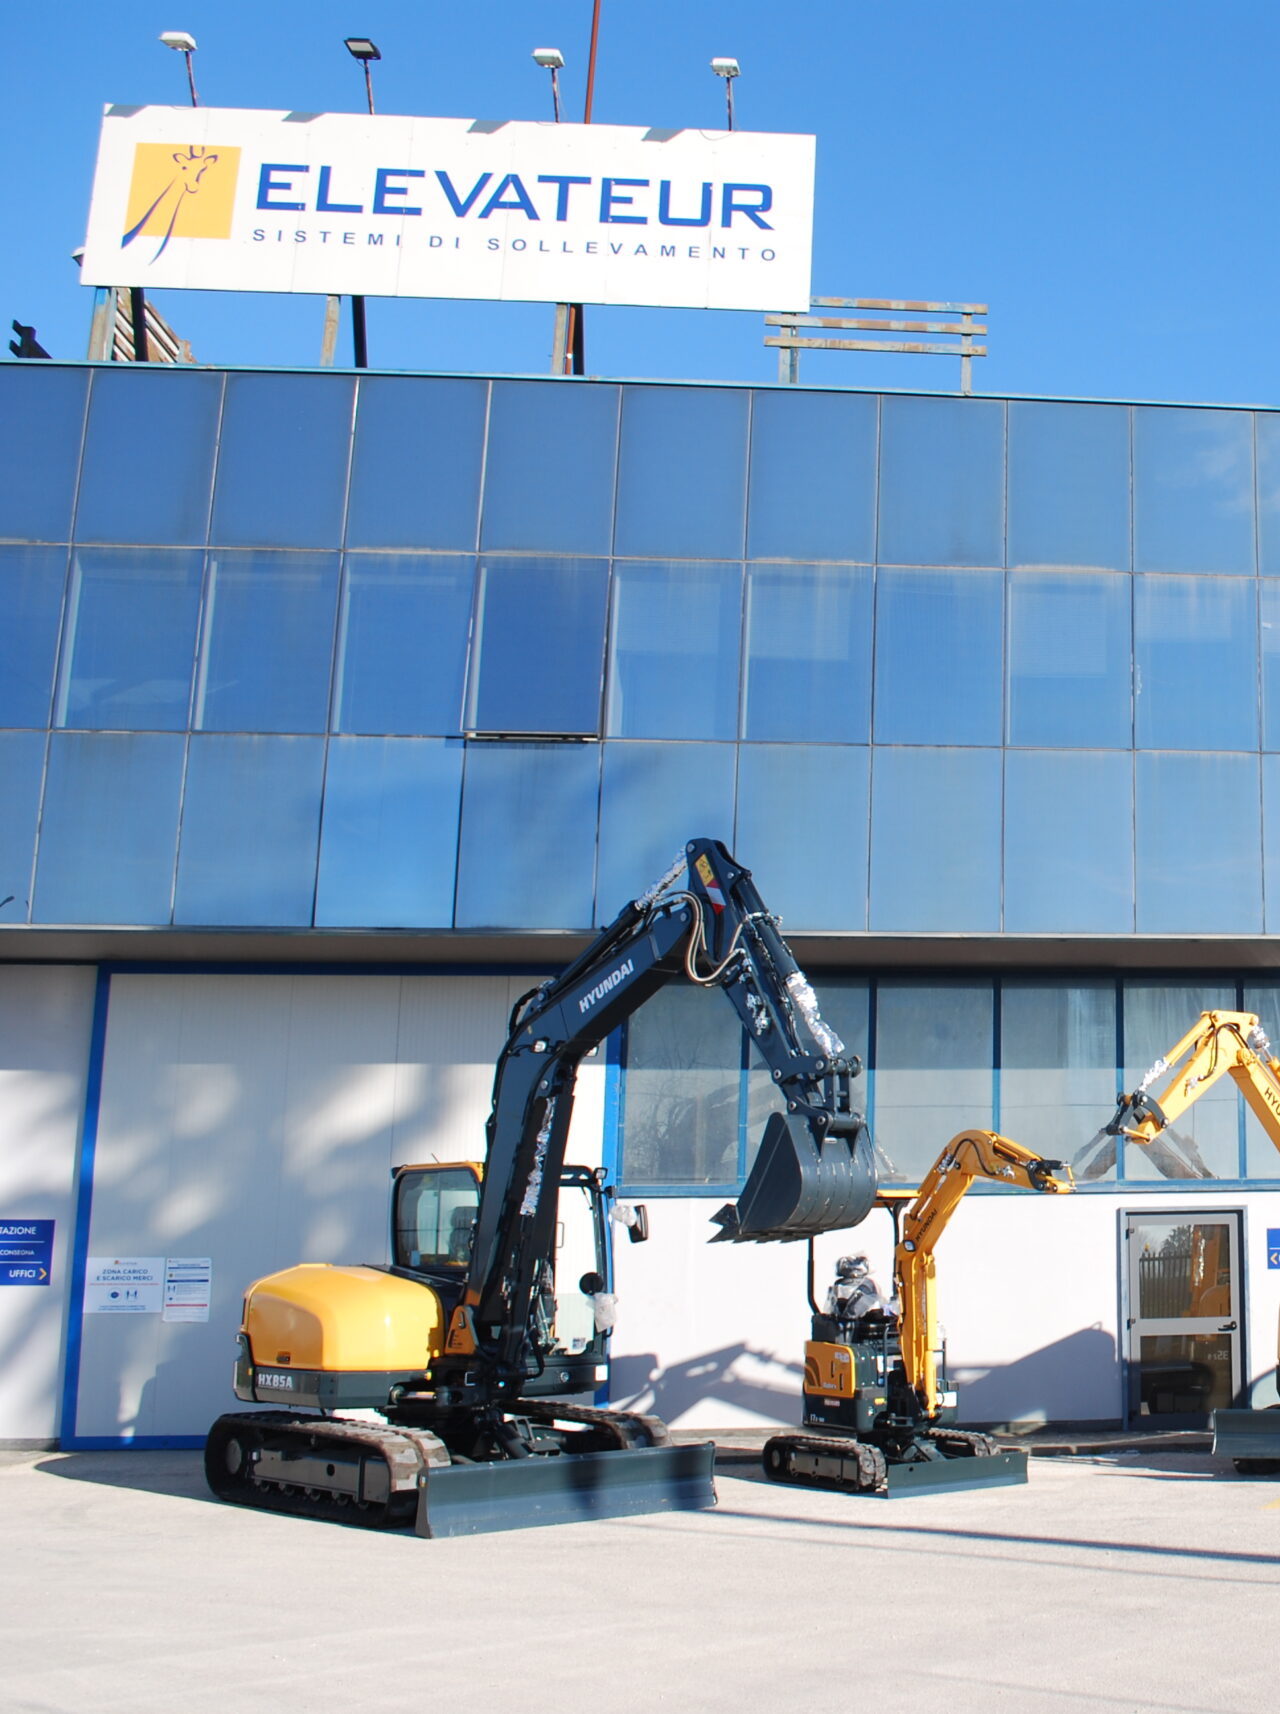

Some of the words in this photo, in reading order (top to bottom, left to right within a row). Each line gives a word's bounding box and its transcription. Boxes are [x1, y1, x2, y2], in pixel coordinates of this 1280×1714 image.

[256, 163, 774, 231] ELEVATEUR
[252, 229, 401, 247] SISTEMI
[430, 236, 461, 250] DI
[487, 238, 777, 262] SOLLEVAMENTO
[579, 958, 635, 1014] HYUNDAI
[9, 1269, 37, 1278] UFFICI
